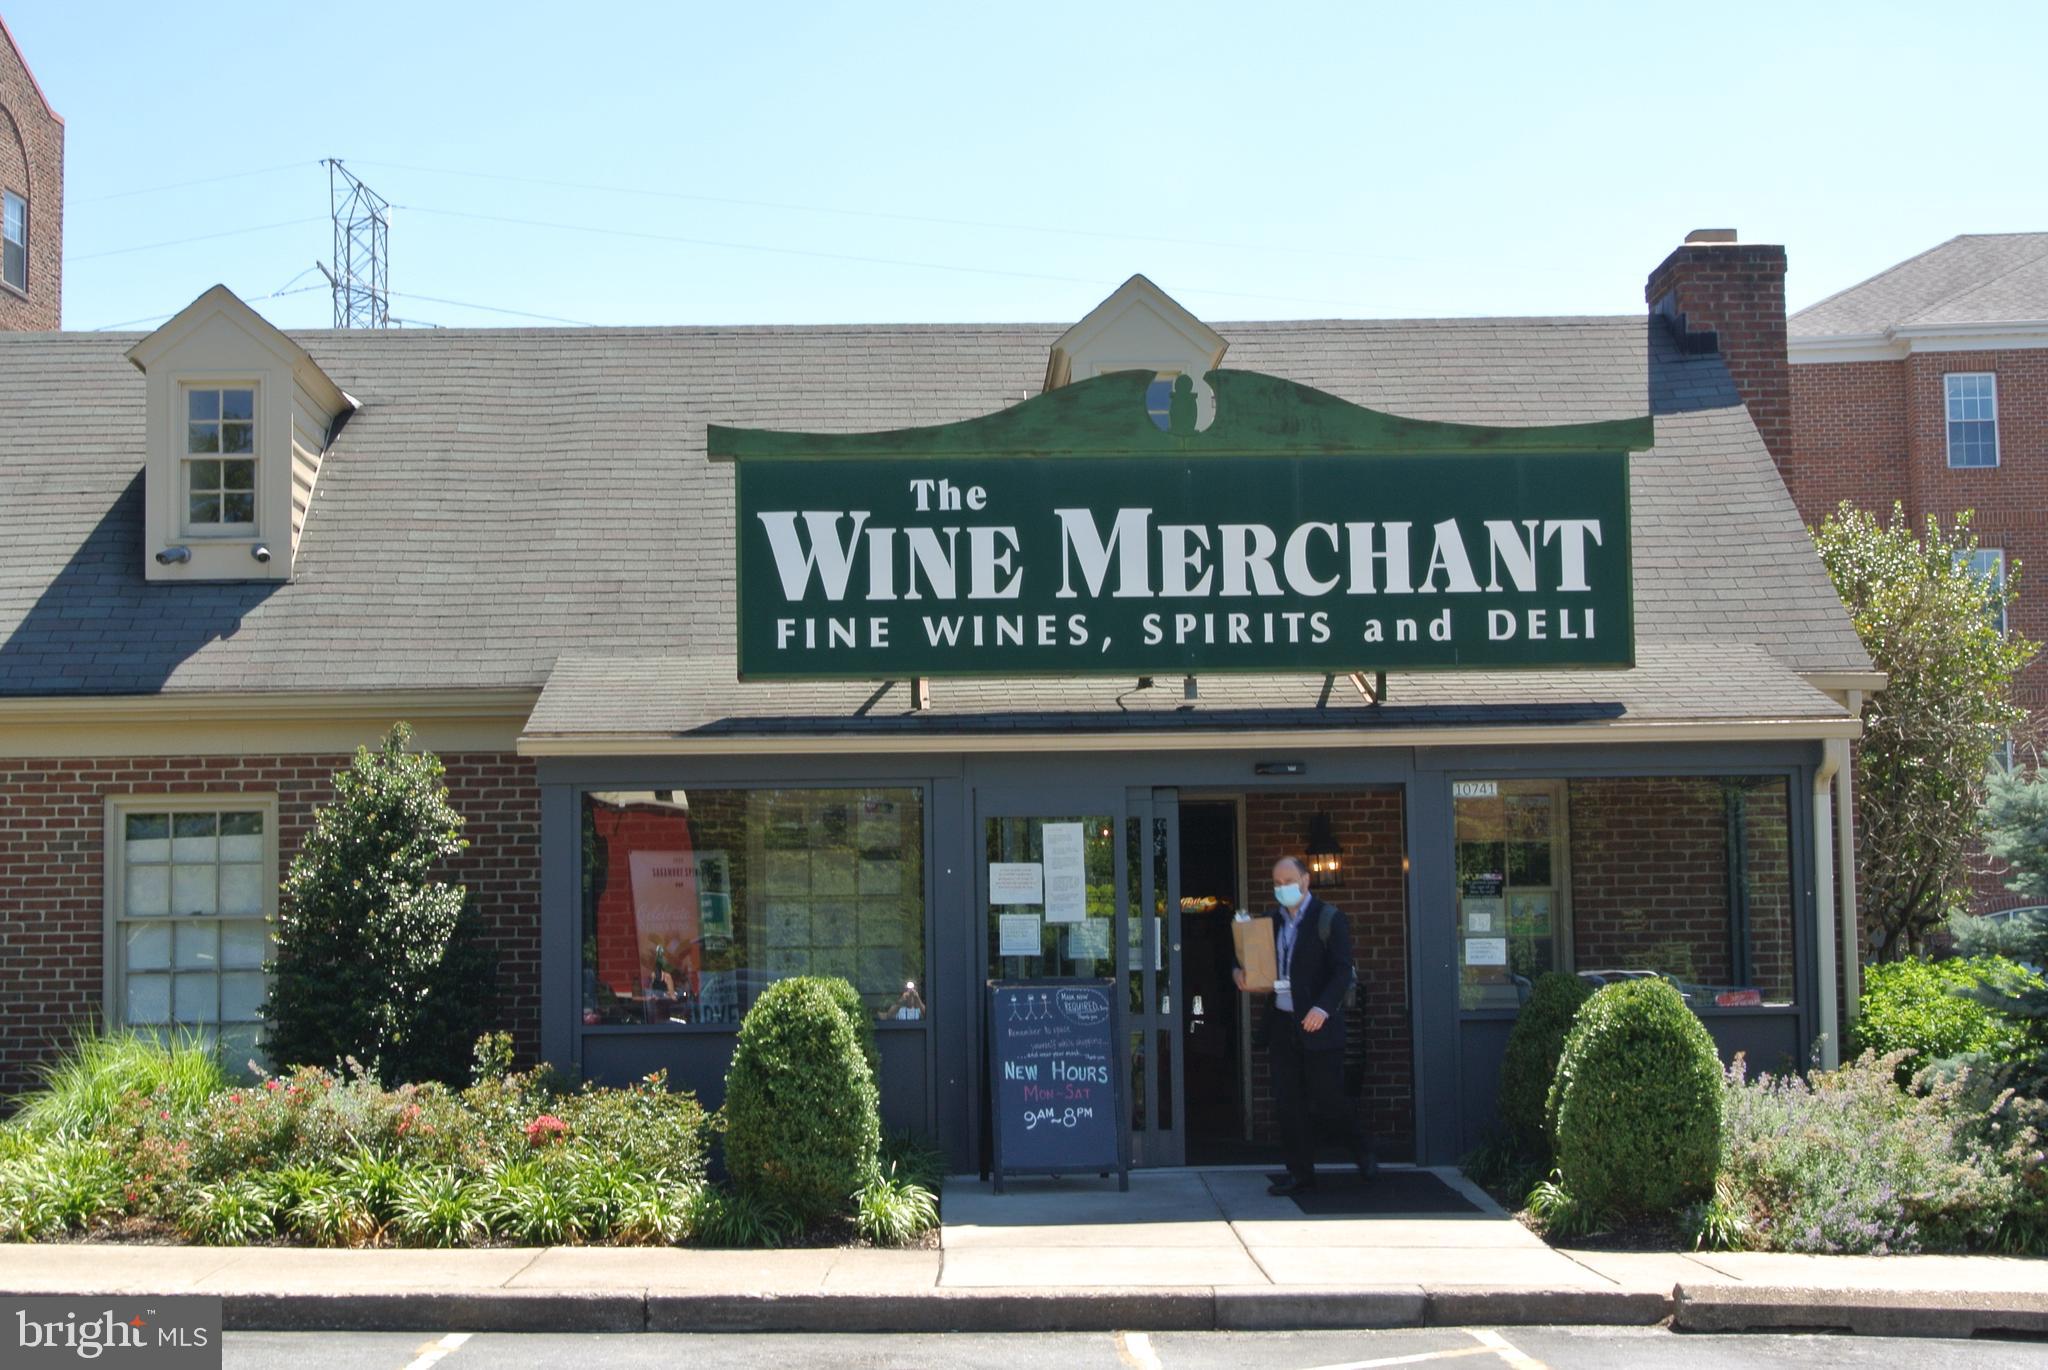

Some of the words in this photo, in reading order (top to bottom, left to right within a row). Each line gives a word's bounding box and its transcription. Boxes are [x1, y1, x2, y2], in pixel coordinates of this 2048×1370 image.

[909, 478, 988, 512] The
[757, 511, 1024, 601] WINE
[1053, 508, 1602, 598] MERCHANT
[777, 617, 889, 649] FINE
[922, 614, 1112, 654] WINES,
[1143, 612, 1331, 645] SPIRITS
[1363, 608, 1452, 642] and
[1488, 608, 1595, 640] DELI
[1456, 783, 1494, 796] 10741
[1004, 1060, 1038, 1080] NEW
[1051, 1060, 1108, 1084] HOURS
